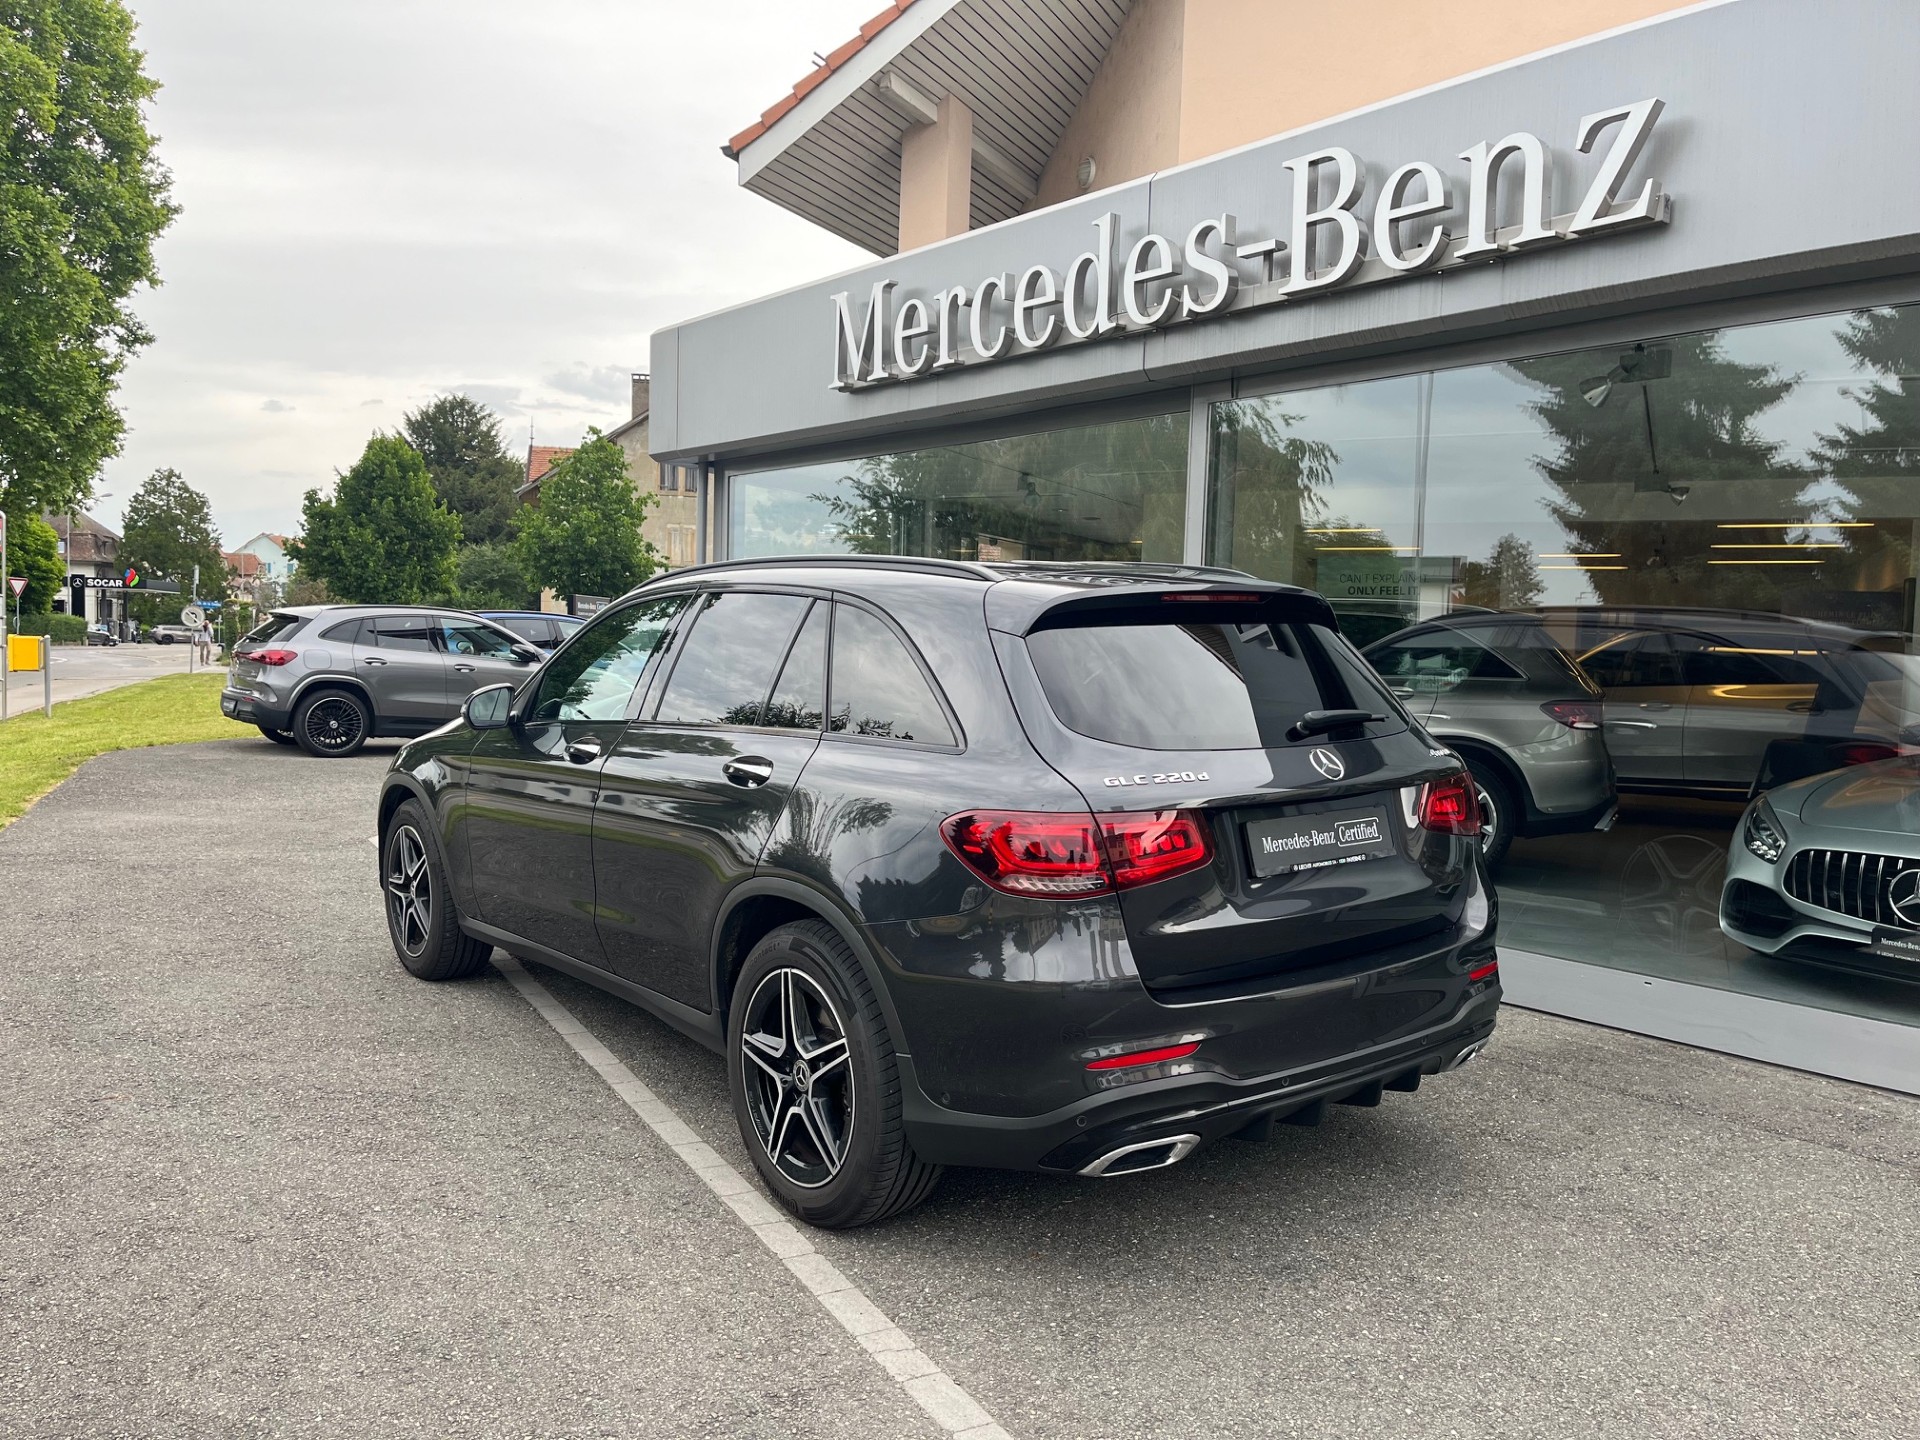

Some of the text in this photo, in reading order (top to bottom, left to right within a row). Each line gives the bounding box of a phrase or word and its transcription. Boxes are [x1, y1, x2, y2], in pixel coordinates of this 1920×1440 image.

[828, 97, 1666, 392] Mercedes-Benz
[87, 579, 123, 587] SOCAR
[1372, 573, 1416, 584] EXPLAIN
[1348, 586, 1377, 595] ONLY
[1380, 586, 1405, 595] FEEL
[1103, 774, 1149, 788] GLC
[1262, 822, 1379, 853] Mercedes-Benz Certified
